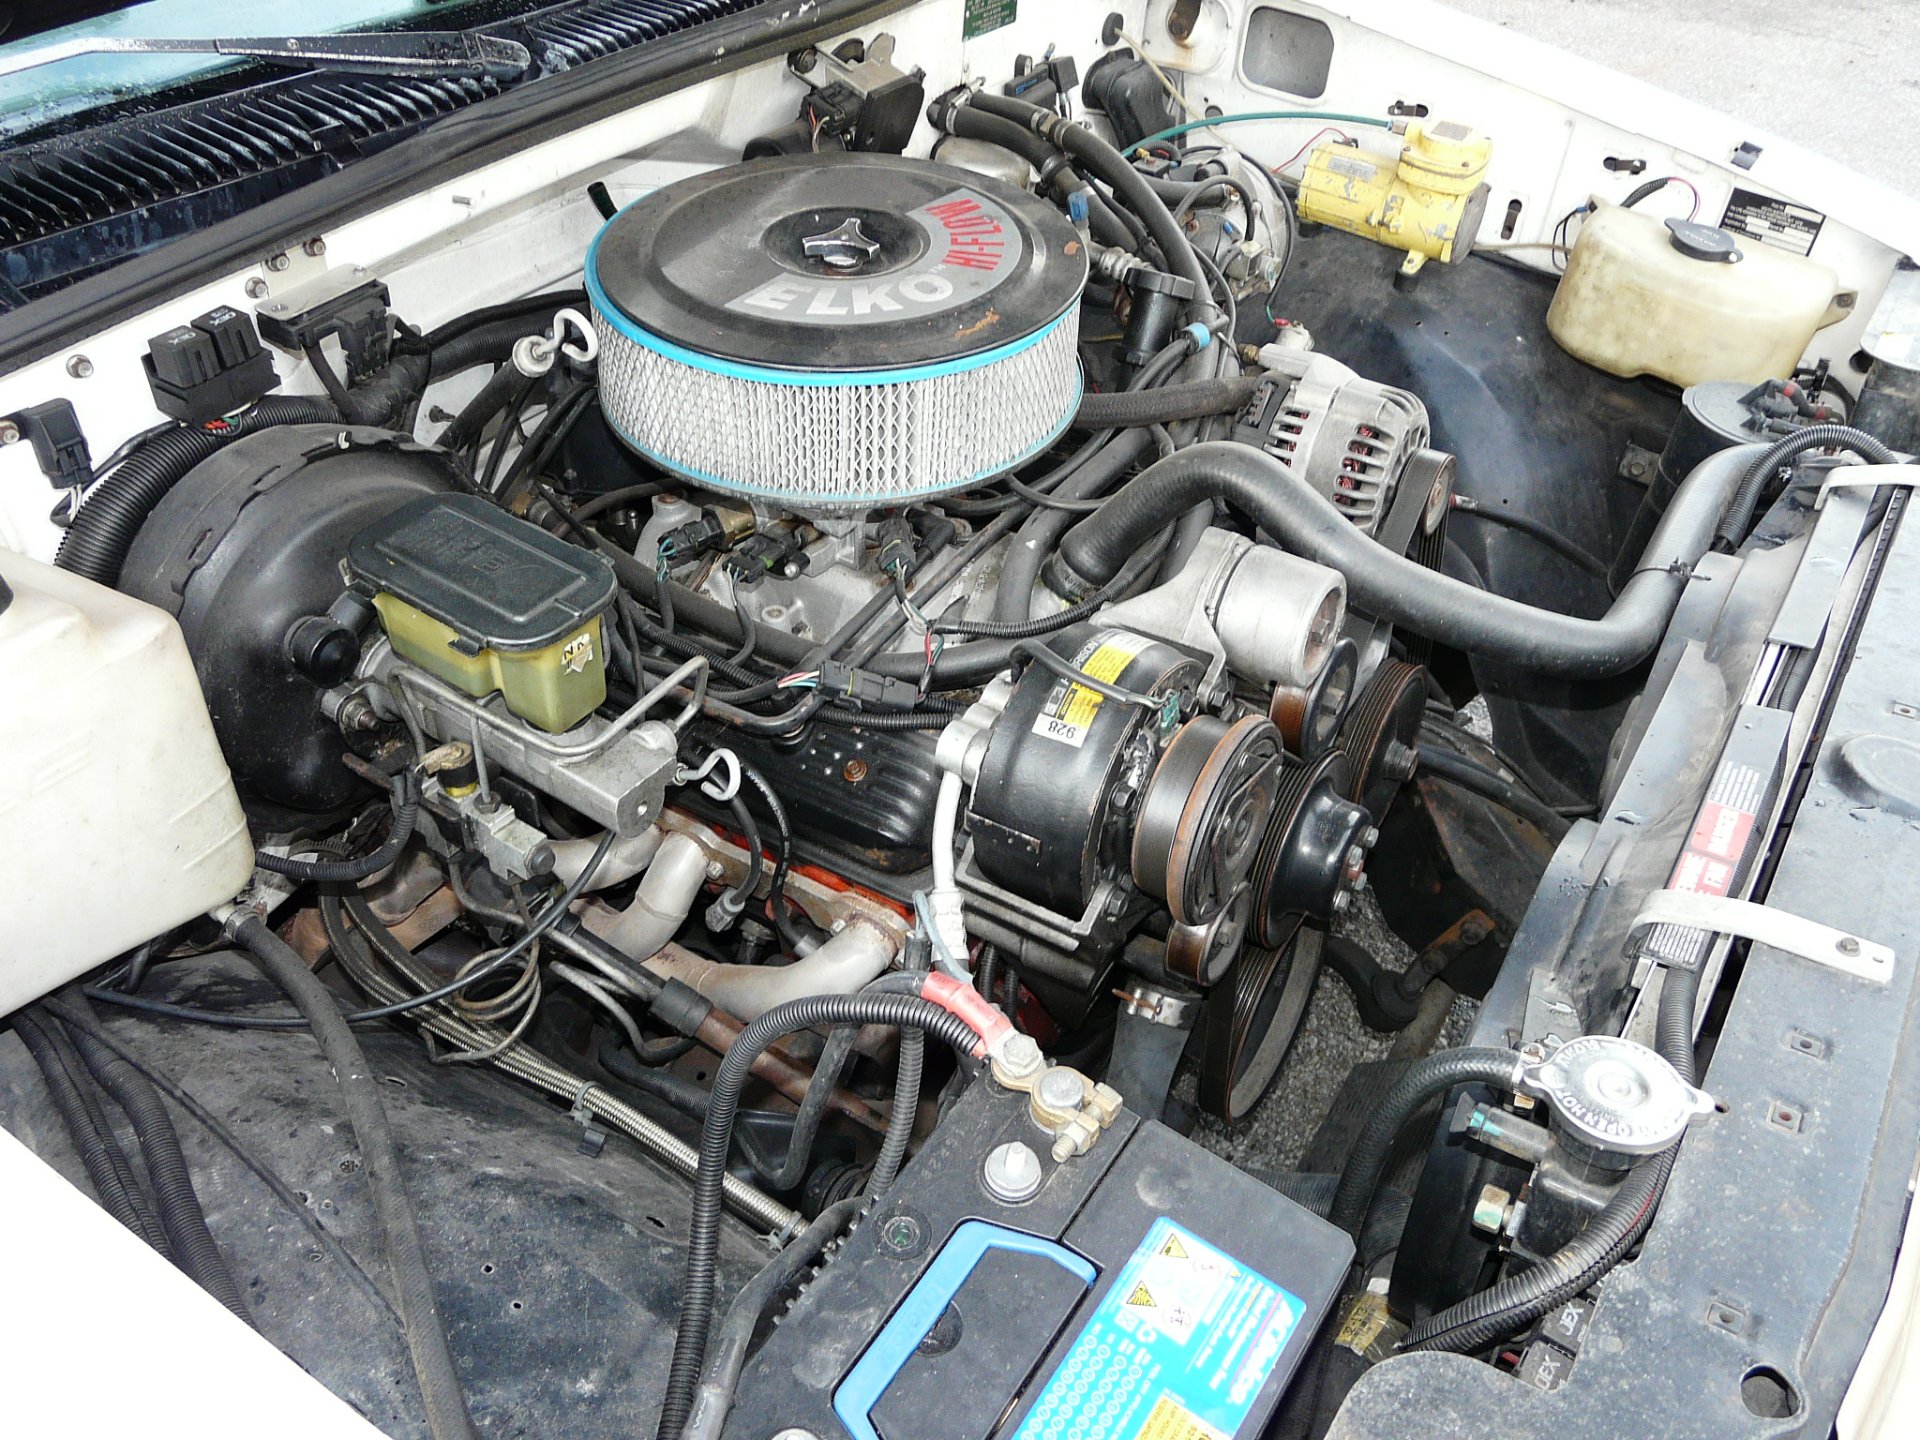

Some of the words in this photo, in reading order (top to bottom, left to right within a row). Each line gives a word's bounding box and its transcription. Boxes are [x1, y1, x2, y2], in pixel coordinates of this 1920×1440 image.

[744, 272, 955, 316] ELKO
[1047, 720, 1077, 739] 928
[1554, 1090, 1583, 1119] HOT
[1584, 1108, 1633, 1137] OPEN
